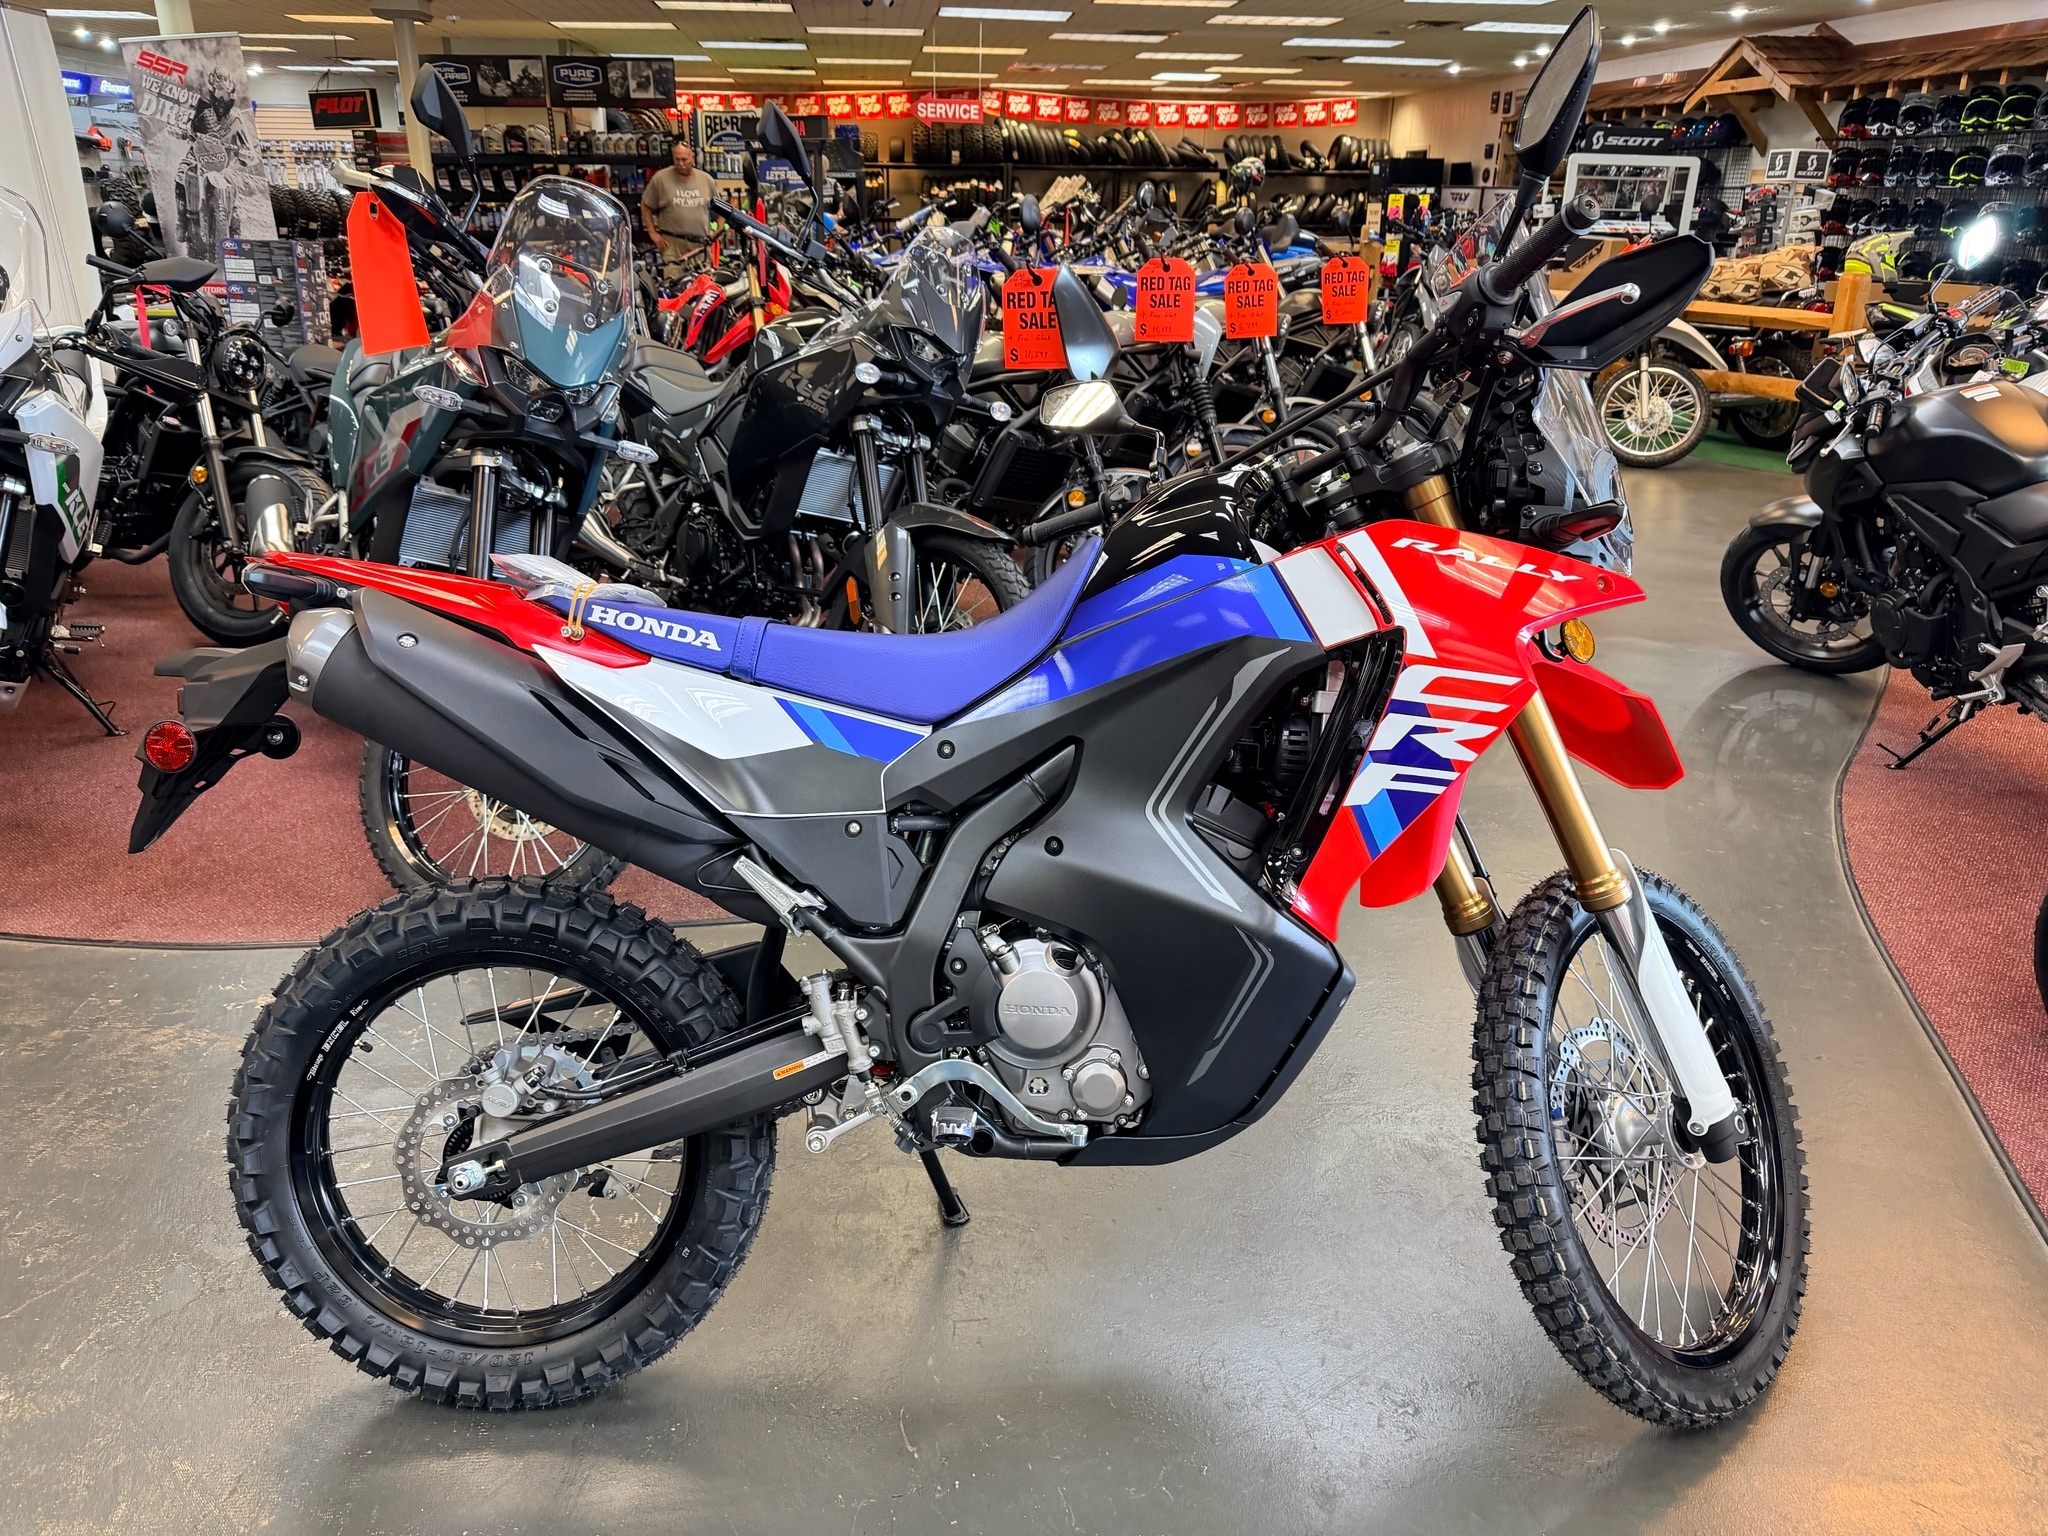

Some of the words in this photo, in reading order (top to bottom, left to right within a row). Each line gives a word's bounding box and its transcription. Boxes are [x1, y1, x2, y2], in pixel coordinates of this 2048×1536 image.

[136, 50, 189, 85] SSR
[560, 68, 595, 78] PURE
[141, 74, 163, 92] WE
[161, 80, 201, 107] KNOW
[315, 96, 364, 115] PILOT
[826, 95, 847, 106] RIDE
[857, 94, 878, 106] RIDE
[1333, 101, 1353, 112] RIDE
[139, 91, 197, 129] DIRT
[798, 103, 820, 116] RED
[830, 103, 851, 117] RED
[860, 102, 882, 116] RED
[917, 102, 980, 120] SERVICE
[1009, 103, 1031, 115] RED
[1039, 105, 1061, 118] RED
[1068, 108, 1090, 121] RED
[1157, 104, 1178, 114] RIDE
[1334, 109, 1356, 122] RED
[1099, 110, 1120, 122] RED
[1128, 111, 1150, 124] RED
[1158, 112, 1180, 125] RED
[1187, 113, 1209, 126] RED
[1217, 113, 1239, 126] RED
[1247, 113, 1268, 125] RED
[1276, 112, 1298, 124] RED
[1305, 110, 1327, 123] RED
[1604, 135, 1665, 148] SCOTT
[765, 170, 786, 181] LET'S
[680, 189, 701, 197] LOVE
[673, 197, 686, 205] MY
[685, 197, 705, 207] WIFE
[1140, 276, 1165, 291] RED
[1168, 276, 1191, 291] TAG
[1324, 272, 1344, 285] RED
[1346, 270, 1366, 283] TAG
[1228, 280, 1250, 294] RED
[1253, 279, 1274, 292] TAG
[1331, 284, 1357, 298] SALE
[1006, 291, 1037, 310] RED
[1040, 290, 1056, 308] TA
[1149, 293, 1181, 309] SALE
[1236, 294, 1265, 309] SALE
[1019, 311, 1057, 330] SALE
[1139, 322, 1148, 337] $
[1229, 322, 1237, 335] $
[1009, 347, 1019, 363] $
[777, 368, 832, 406] KLE
[1390, 536, 1584, 584] RALLY
[587, 603, 722, 652] HONDA
[1342, 663, 1525, 807] CRF
[1003, 1003, 1072, 1017] HONDA
[321, 1020, 350, 1053] EXCEL
